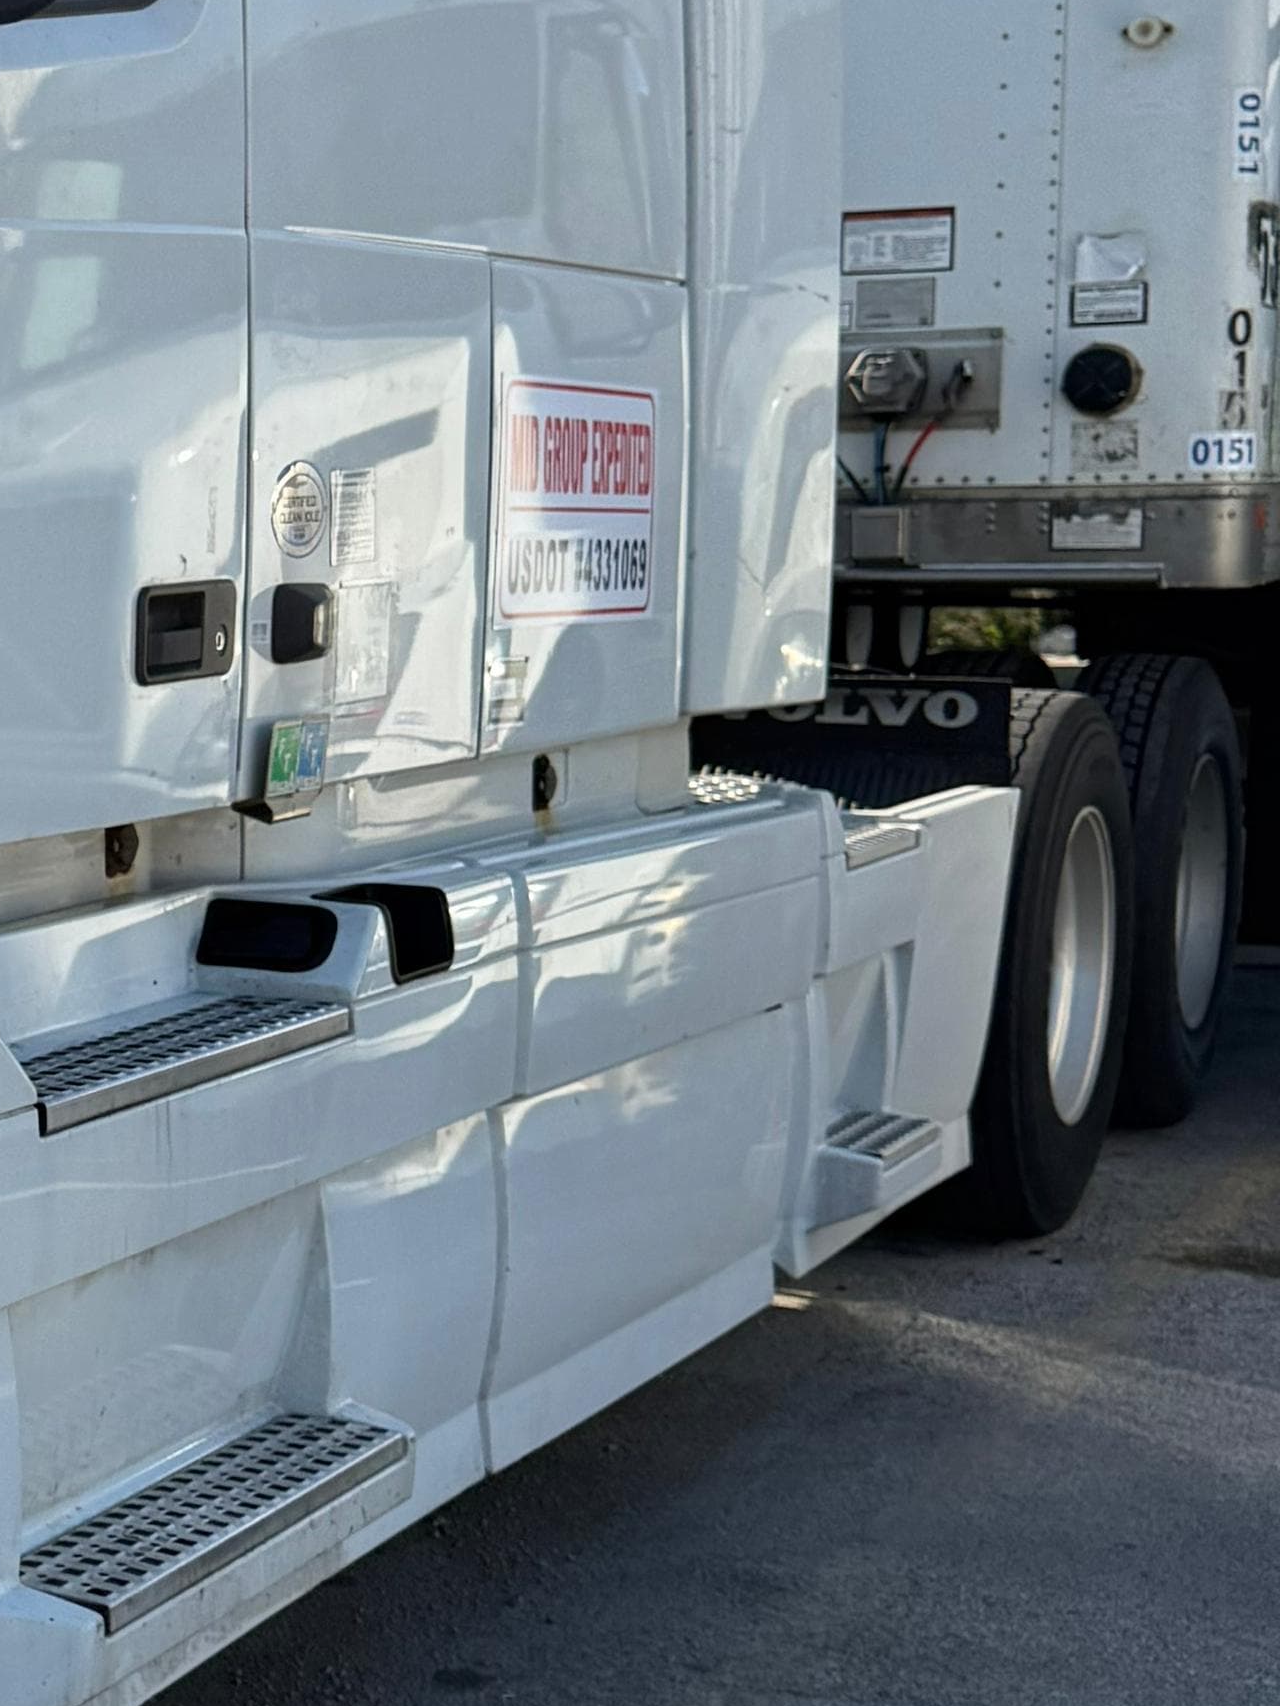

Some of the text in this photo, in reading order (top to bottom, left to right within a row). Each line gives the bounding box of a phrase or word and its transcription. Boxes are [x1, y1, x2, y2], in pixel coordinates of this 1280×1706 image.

[1238, 94, 1261, 175] 0151
[543, 414, 589, 495] GROUP
[591, 419, 651, 496] EXPEDITED
[1192, 438, 1254, 465] 0151
[506, 537, 648, 596] USDOT #4331069
[723, 688, 980, 729] LVO
